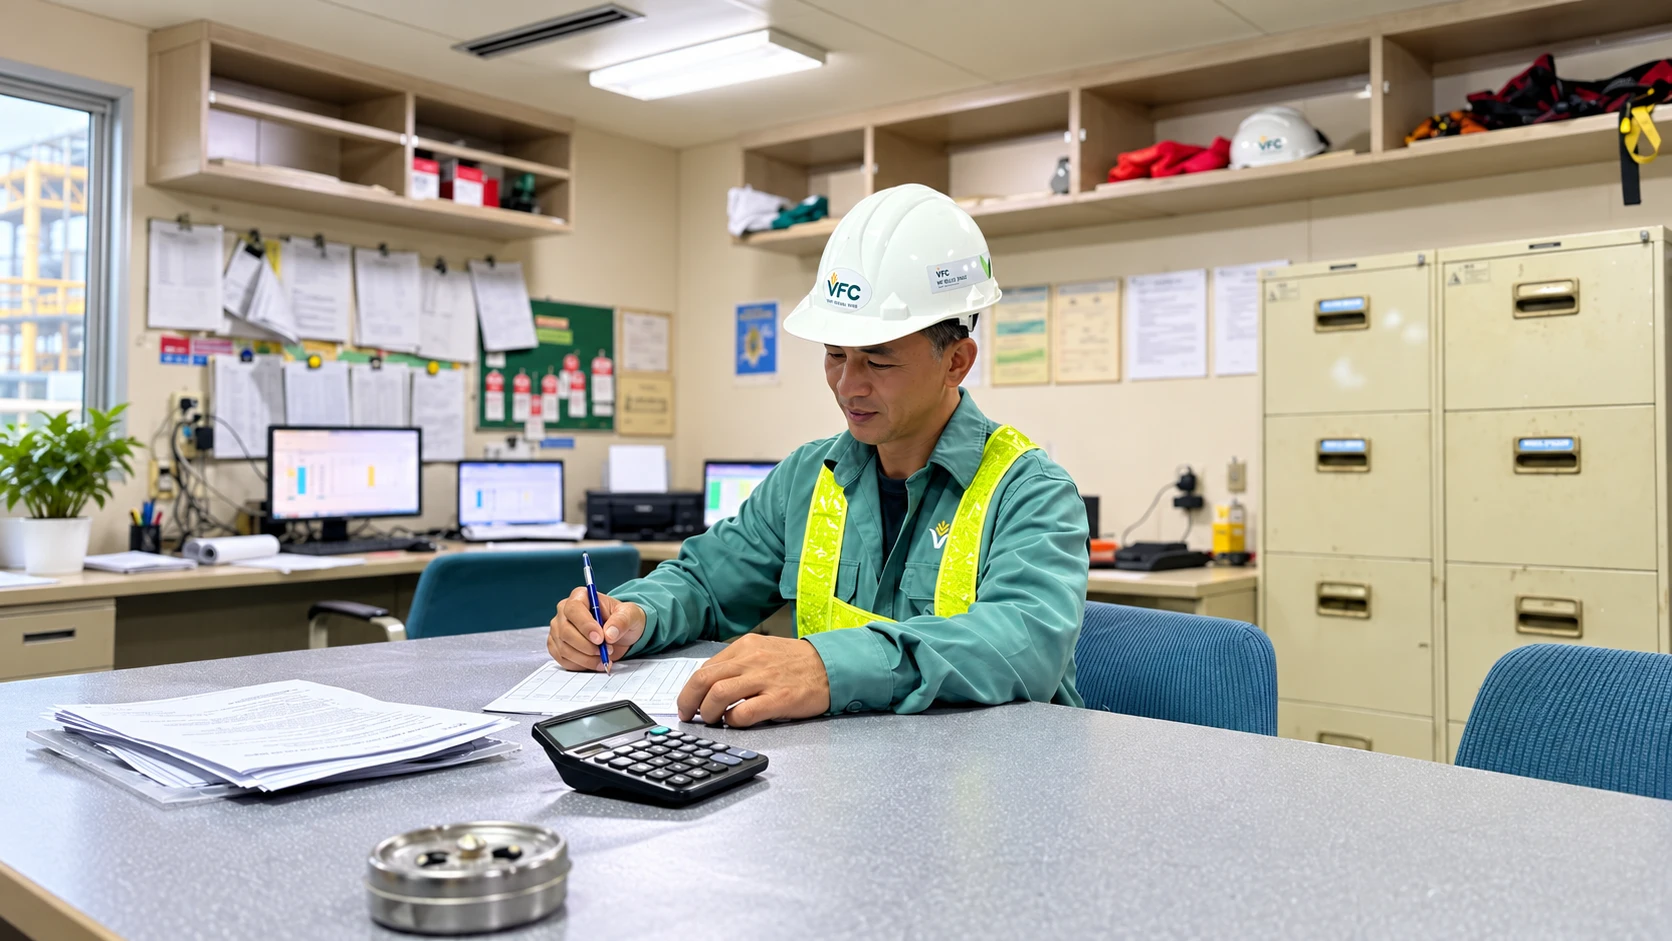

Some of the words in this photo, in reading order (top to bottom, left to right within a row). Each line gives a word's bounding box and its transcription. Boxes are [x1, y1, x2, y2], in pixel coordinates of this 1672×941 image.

[1259, 139, 1282, 150] VFC
[935, 269, 950, 278] VFC
[827, 279, 861, 301] VFC
